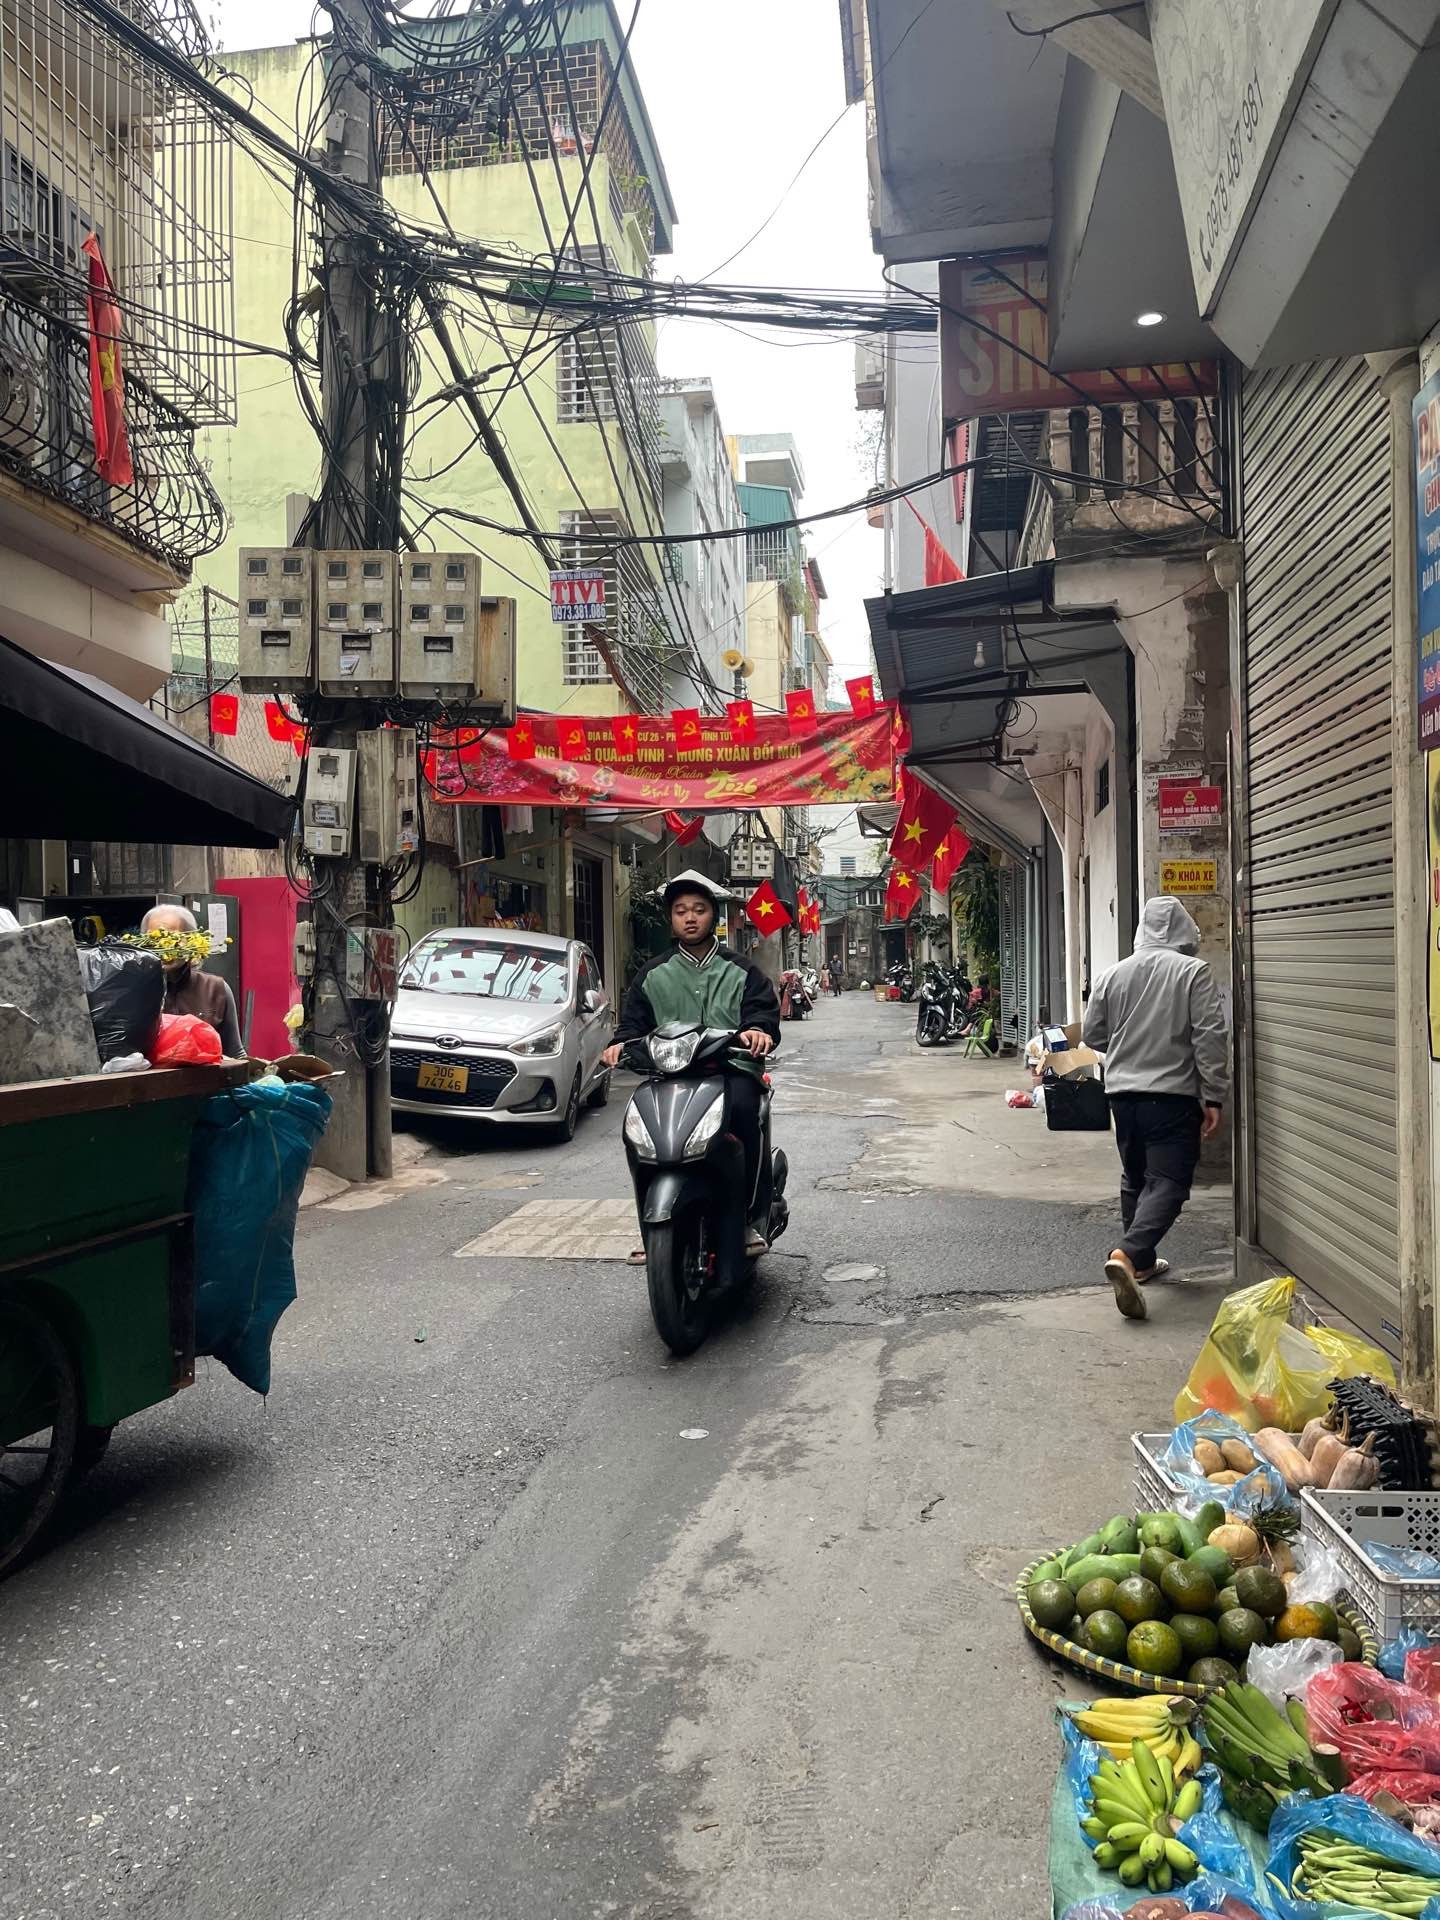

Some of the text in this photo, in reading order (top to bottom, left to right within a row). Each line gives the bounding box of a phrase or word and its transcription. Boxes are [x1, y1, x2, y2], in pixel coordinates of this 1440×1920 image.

[1207, 67, 1263, 248] 0978 487 981
[551, 580, 604, 605] TIVI
[649, 732, 659, 741] 26
[637, 747, 665, 762] VINH
[716, 744, 750, 762] XUÂN
[753, 740, 774, 761] ĐỔI
[777, 741, 801, 759] MỚI
[665, 765, 704, 780] Xuân
[704, 769, 758, 800] 2026
[1178, 868, 1214, 881] KHÓA XE
[375, 934, 395, 966] XE
[433, 1066, 455, 1079] 30G
